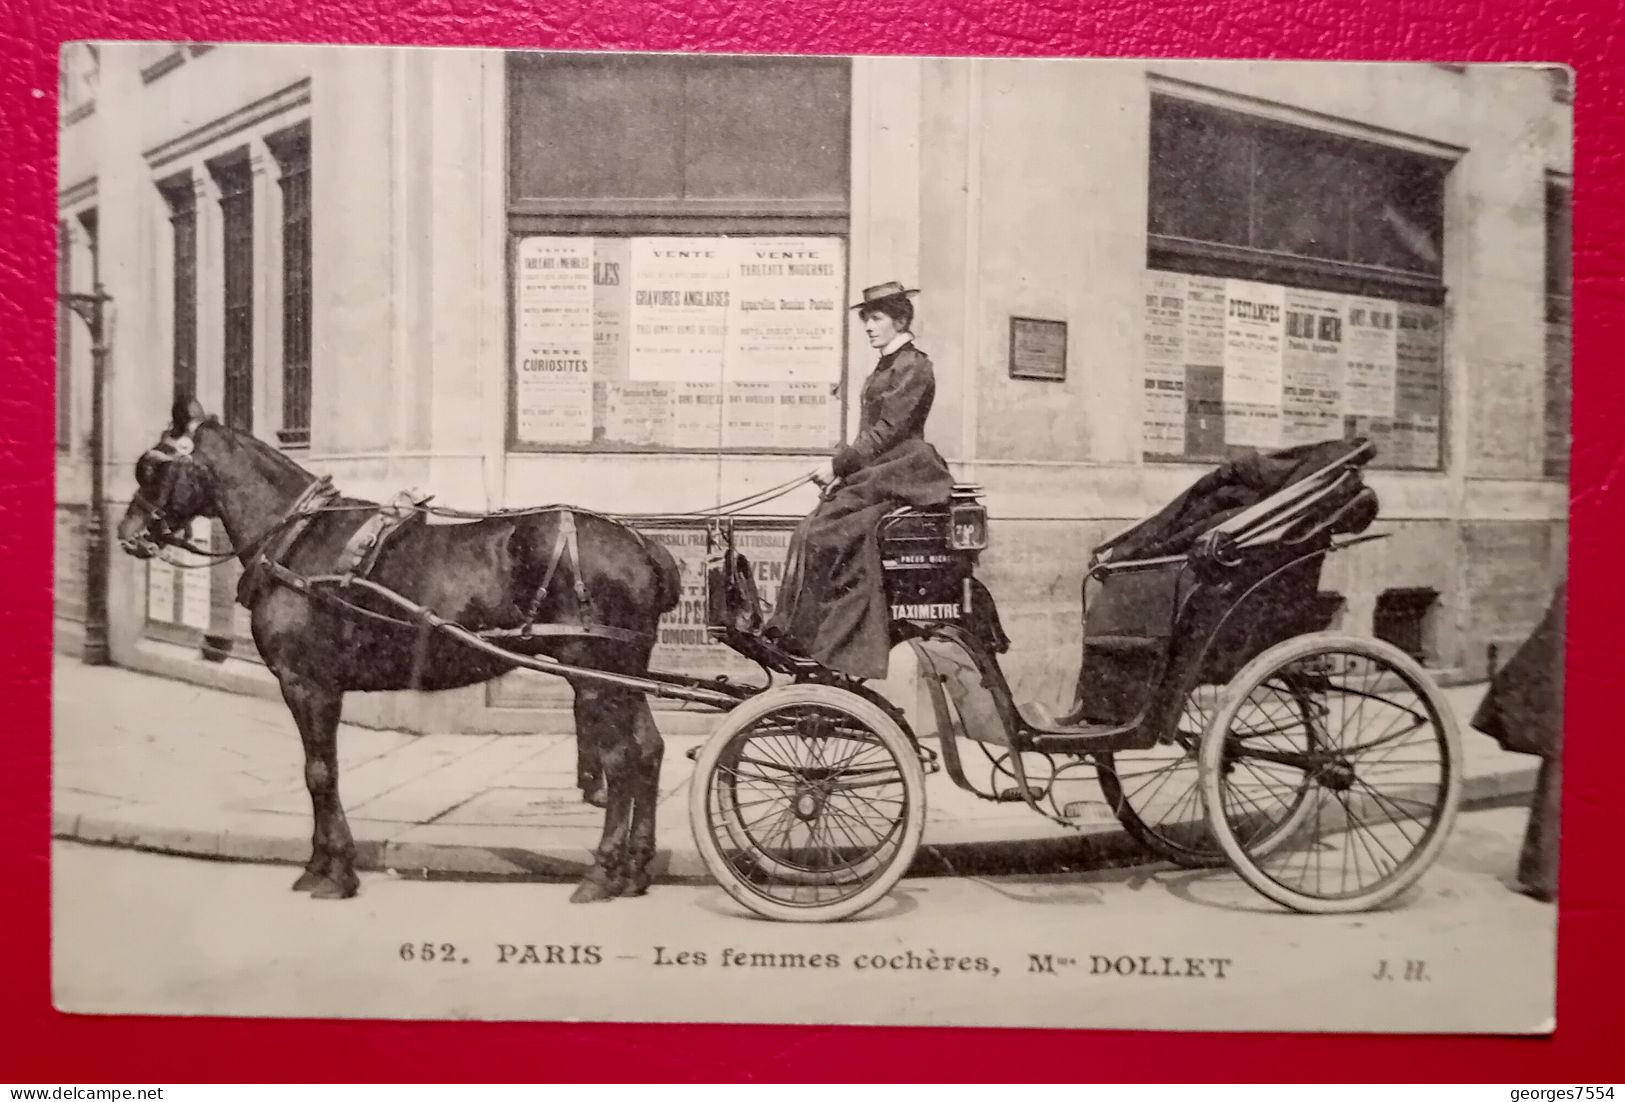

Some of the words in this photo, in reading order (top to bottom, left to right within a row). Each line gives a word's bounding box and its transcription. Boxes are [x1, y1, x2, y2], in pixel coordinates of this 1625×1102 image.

[653, 250, 716, 258] VENTE
[755, 251, 820, 259] VENTE
[740, 264, 783, 276] TABLEAUX
[788, 264, 834, 276] MODERNES
[635, 290, 681, 307] GRAVURES
[683, 290, 730, 307] ANGLAISES
[523, 359, 588, 373] CURIOSITES
[889, 603, 961, 620] TAXIMETRE
